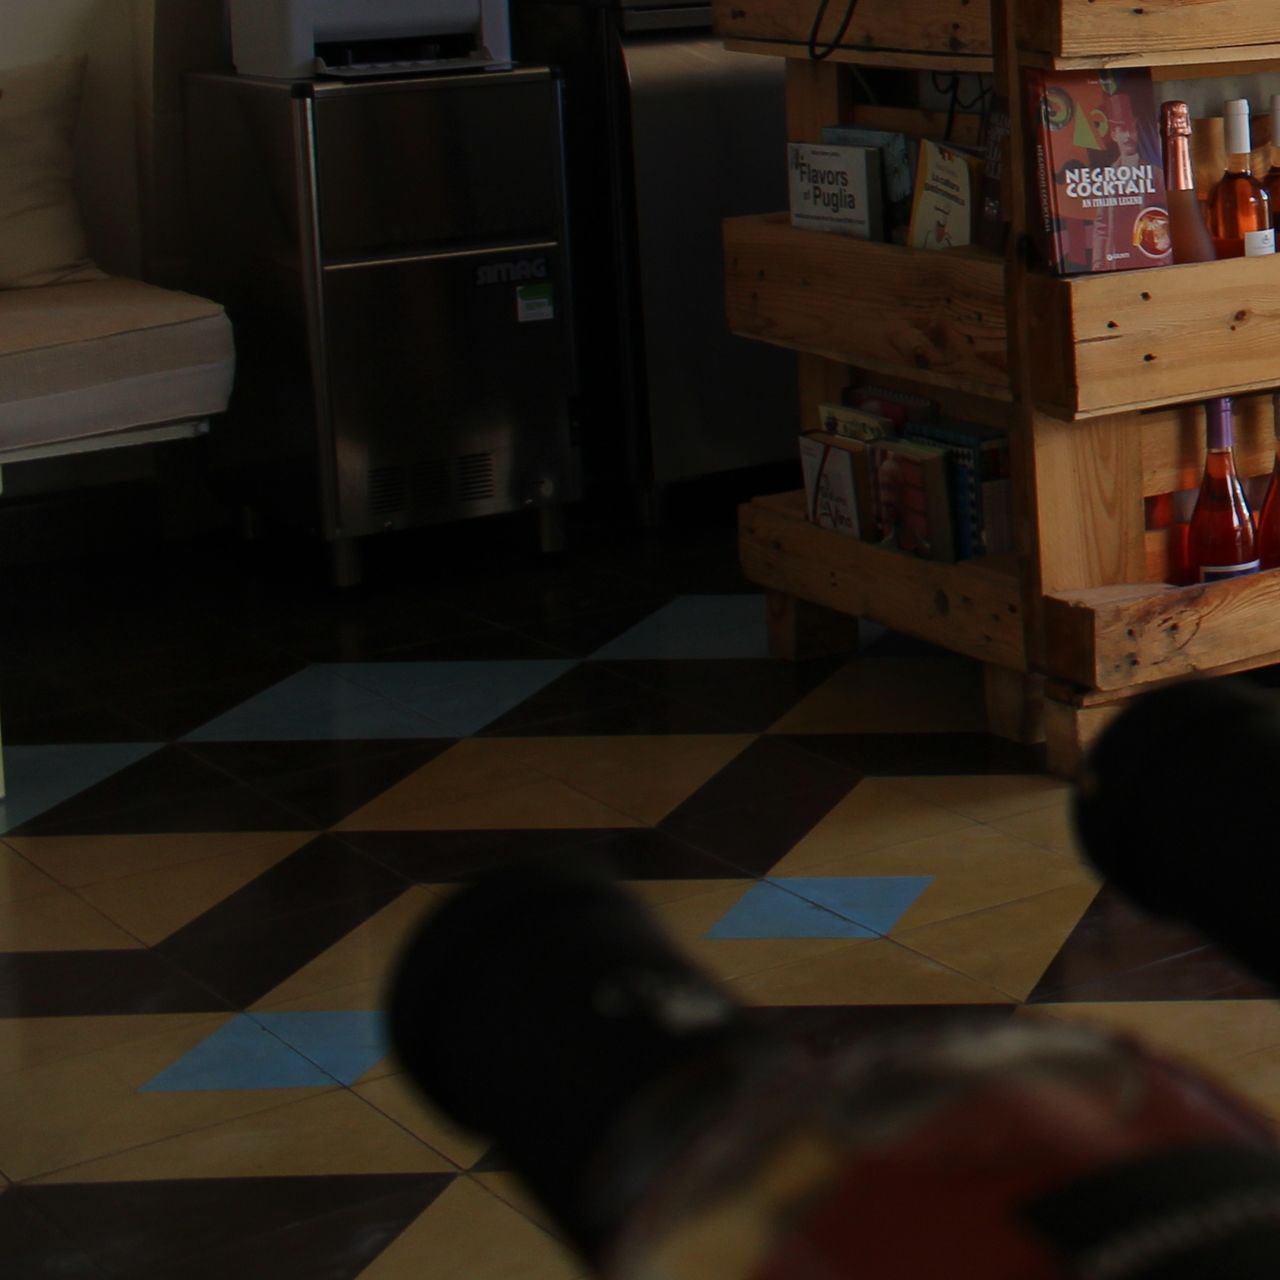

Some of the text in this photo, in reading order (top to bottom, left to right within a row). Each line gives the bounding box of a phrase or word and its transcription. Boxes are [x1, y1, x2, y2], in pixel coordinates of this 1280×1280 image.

[799, 162, 849, 187] Flavors
[1064, 165, 1153, 185] NEGRONI
[803, 186, 856, 213] of Puglia
[1066, 179, 1156, 199] COCKTAIL
